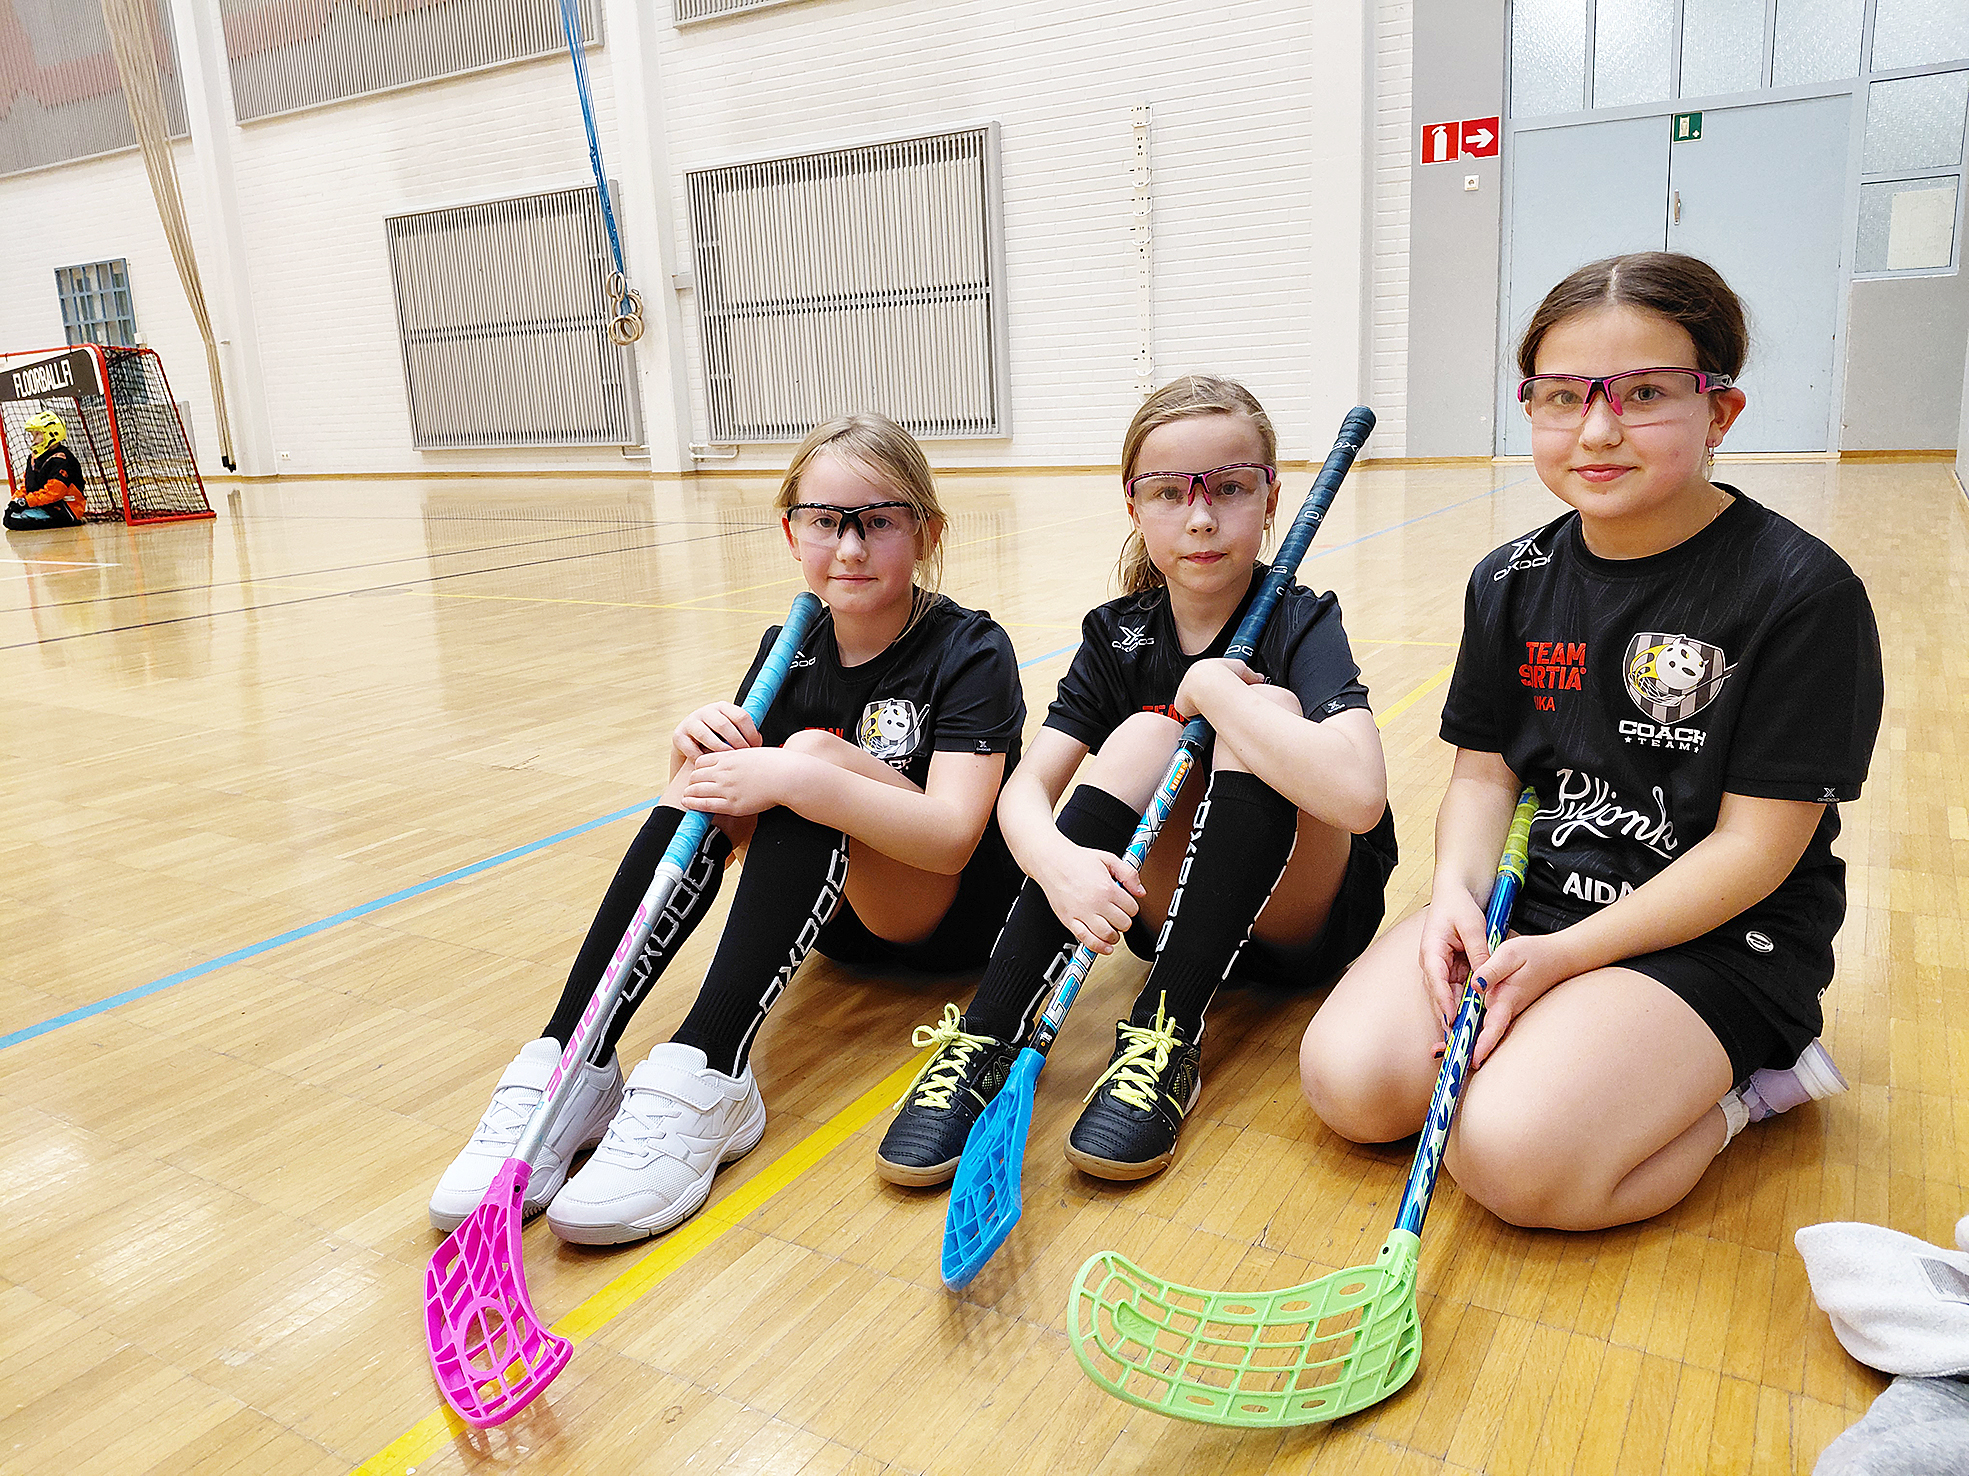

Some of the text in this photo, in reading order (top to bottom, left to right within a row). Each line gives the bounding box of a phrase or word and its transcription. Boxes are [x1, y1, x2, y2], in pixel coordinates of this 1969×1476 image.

[1525, 641, 1587, 666] TEAM
[1618, 719, 1707, 747] COACH
[1637, 737, 1691, 752] TEAM
[758, 849, 850, 1014] OXDOG
